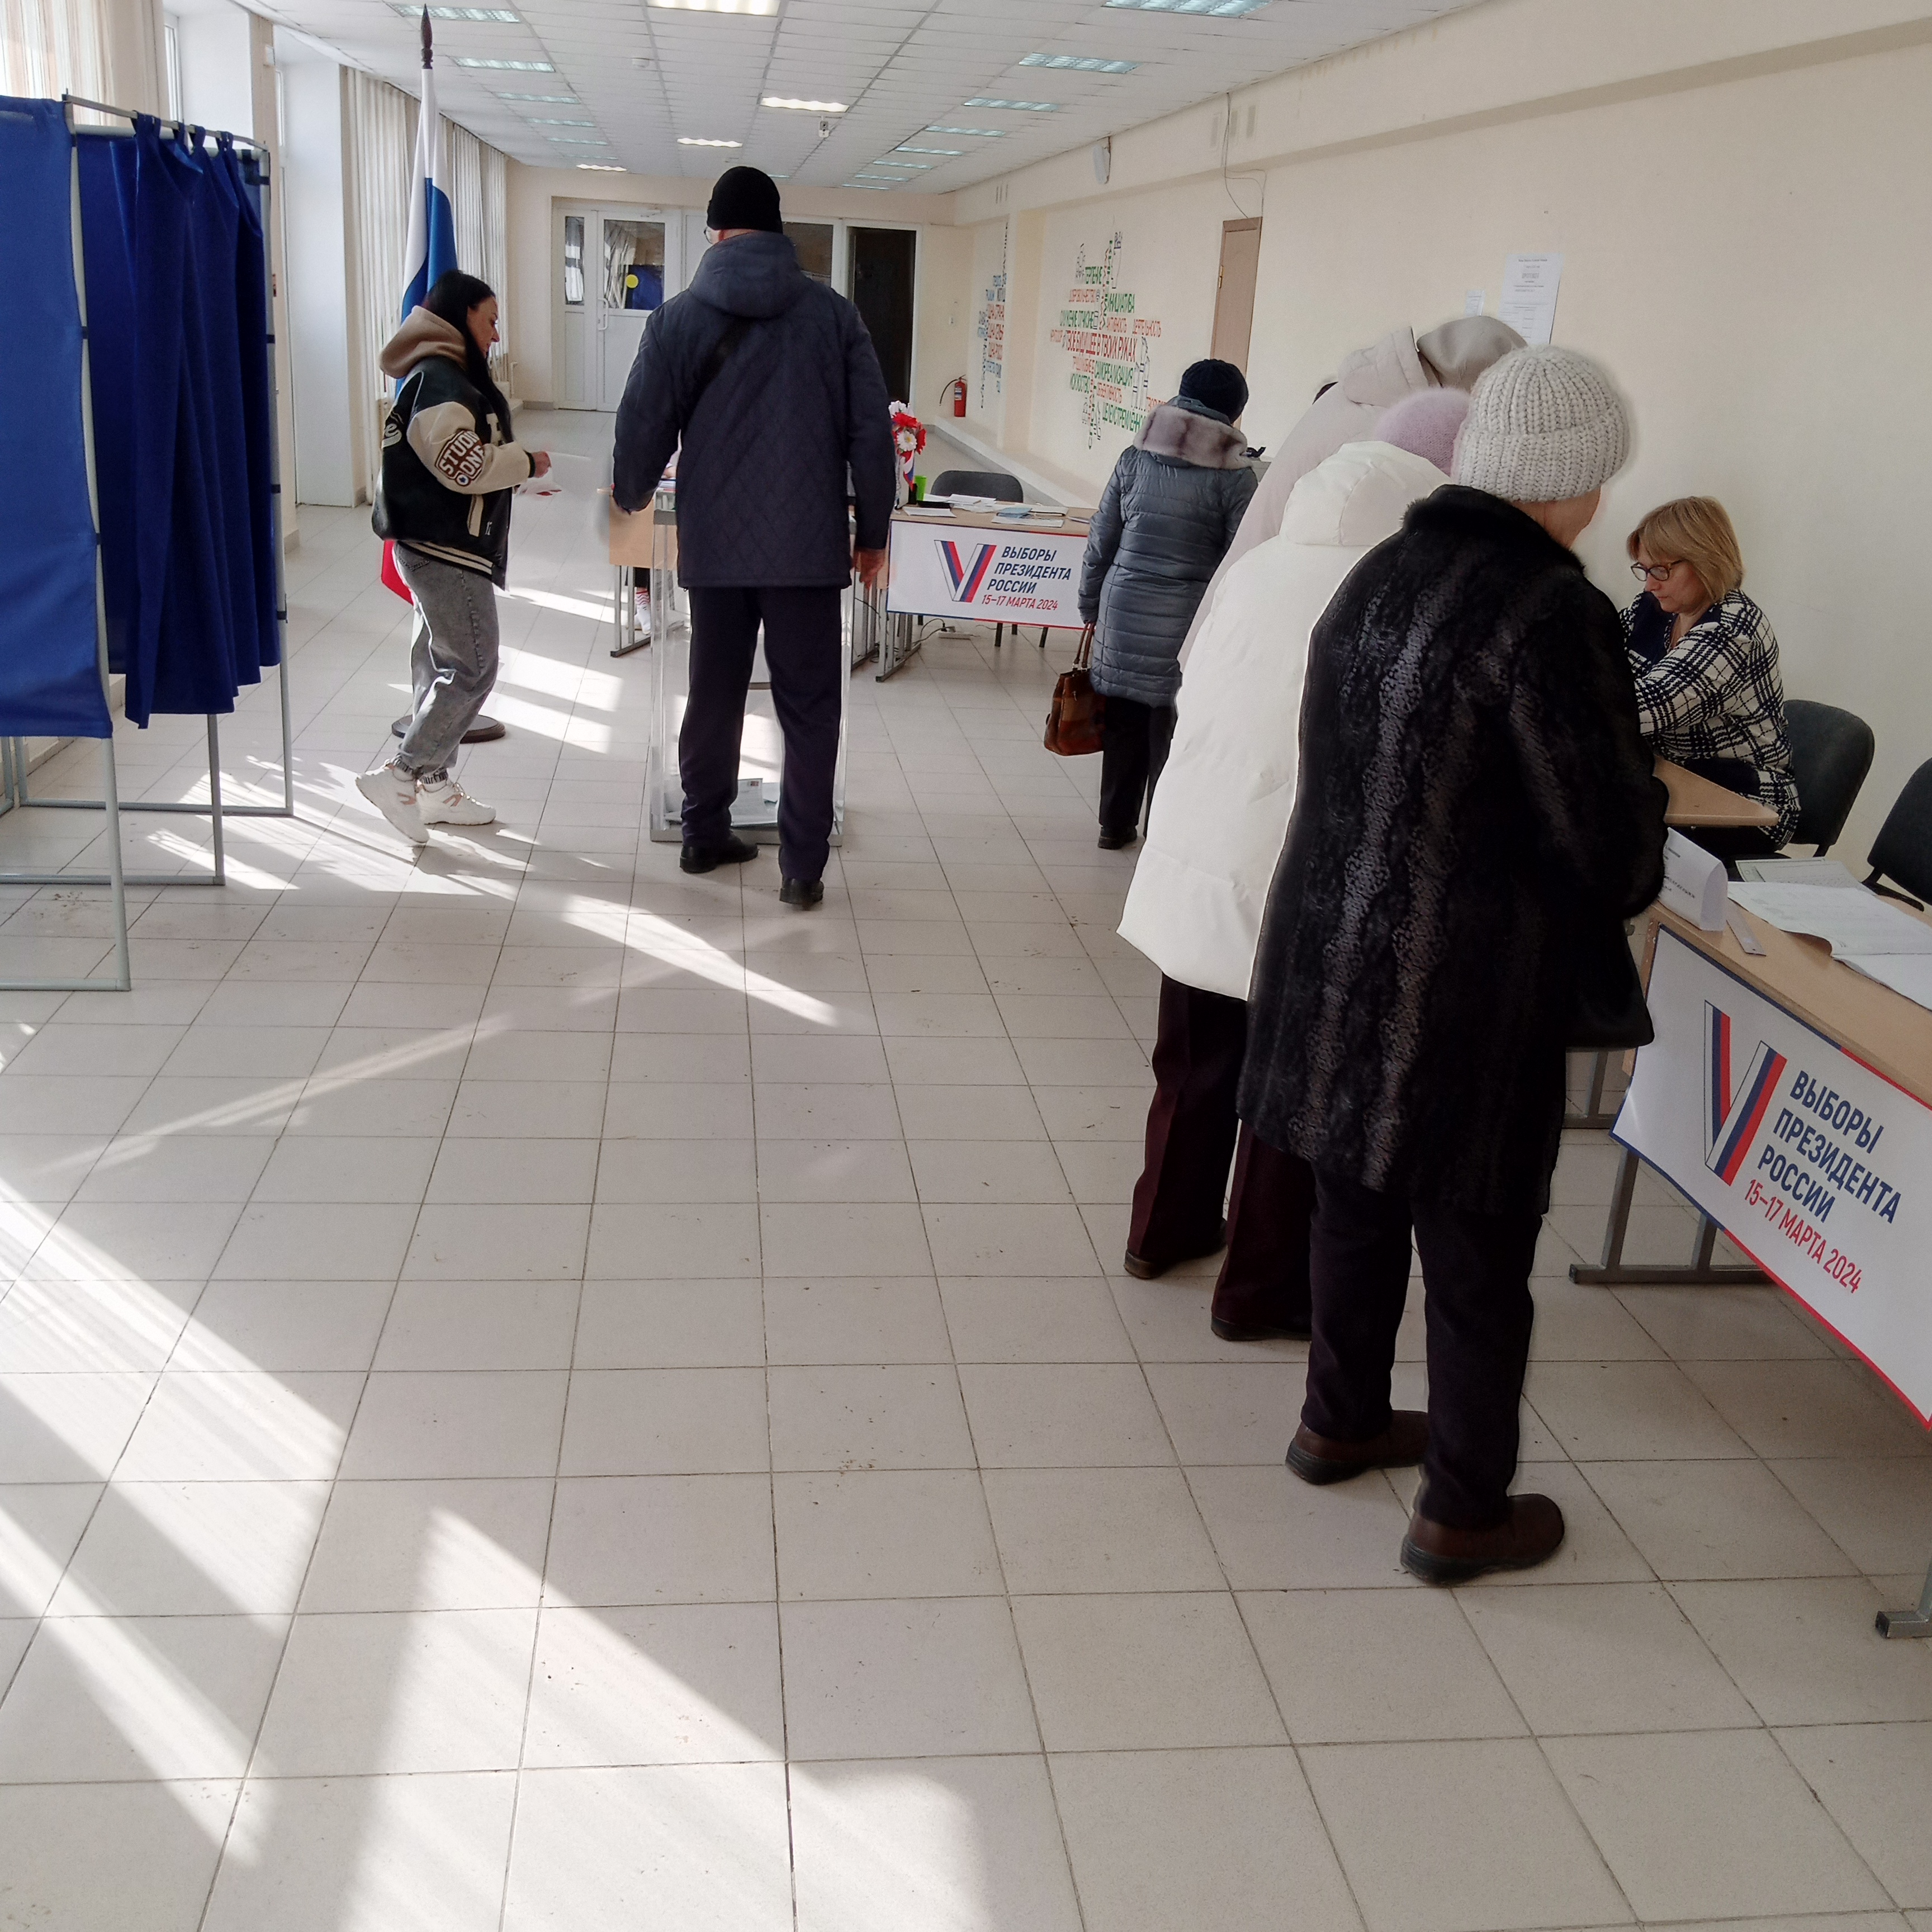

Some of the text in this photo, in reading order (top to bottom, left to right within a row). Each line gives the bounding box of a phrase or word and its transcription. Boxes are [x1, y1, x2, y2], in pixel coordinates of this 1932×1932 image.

[994, 562, 1072, 580] ПРЕЗИДЕНТА
[1001, 546, 1057, 562] ВЫБОРЫ
[987, 579, 1038, 594] РОССИИ
[1006, 596, 1036, 609] МАРТА
[1036, 599, 1058, 610] 2024
[1789, 1070, 1884, 1154] ВЫБОРЫ
[1757, 1144, 1836, 1223] РОССИИ
[1773, 1107, 1901, 1224] ПРЕЗИДЕНТА
[1778, 1208, 1827, 1265] МАРТА
[1822, 1248, 1863, 1294] 2024
